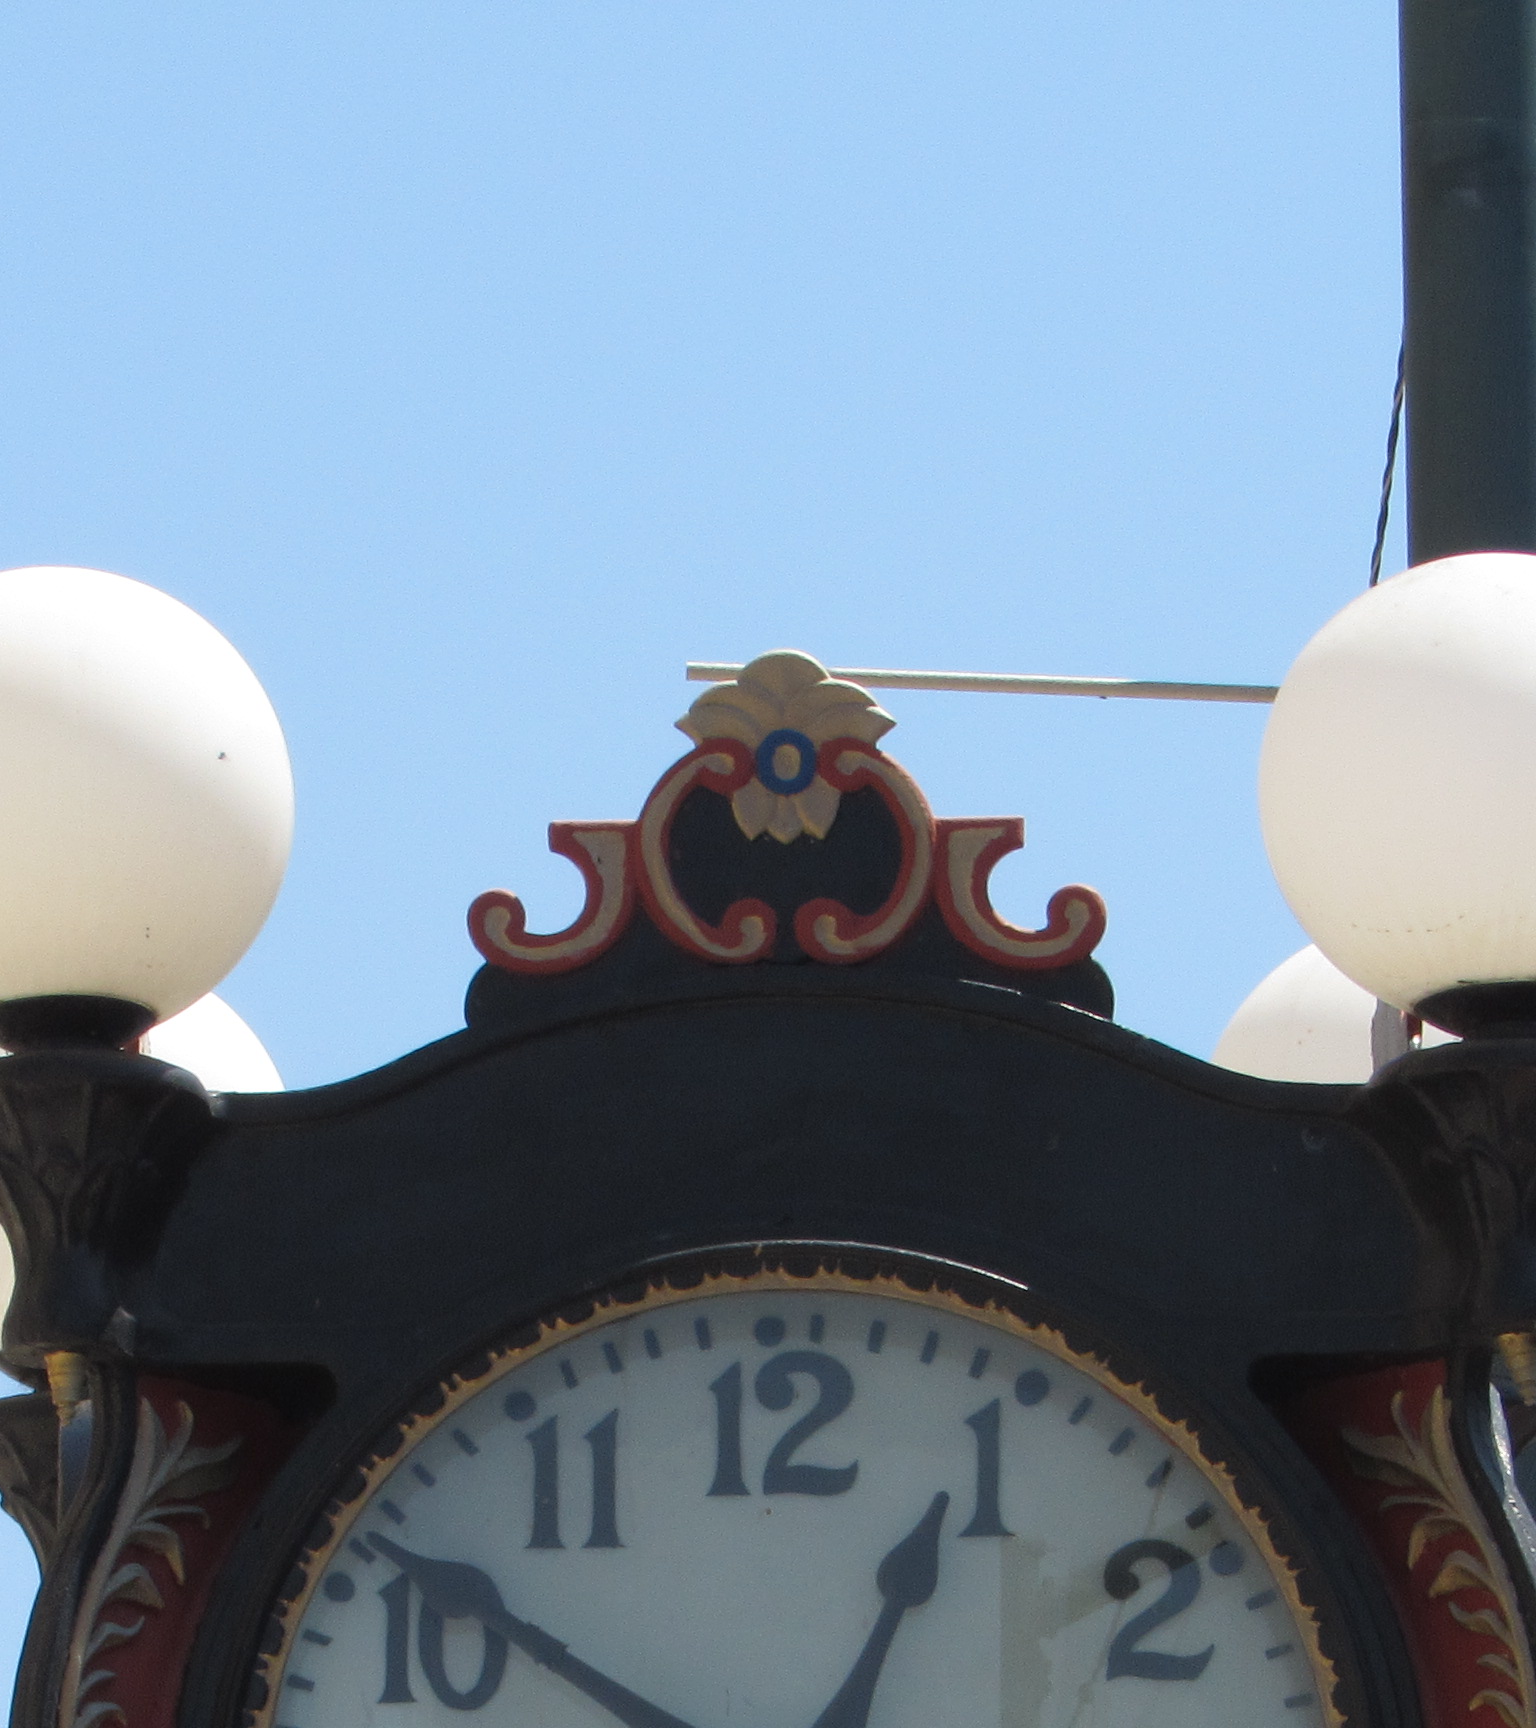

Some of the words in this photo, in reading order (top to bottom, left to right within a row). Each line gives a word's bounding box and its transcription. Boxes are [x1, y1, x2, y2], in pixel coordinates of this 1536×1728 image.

[523, 1407, 627, 1550] 11
[708, 1351, 859, 1498] 12
[956, 1398, 1017, 1539] 1
[377, 1564, 509, 1711] 10
[1103, 1539, 1215, 1682] 2
